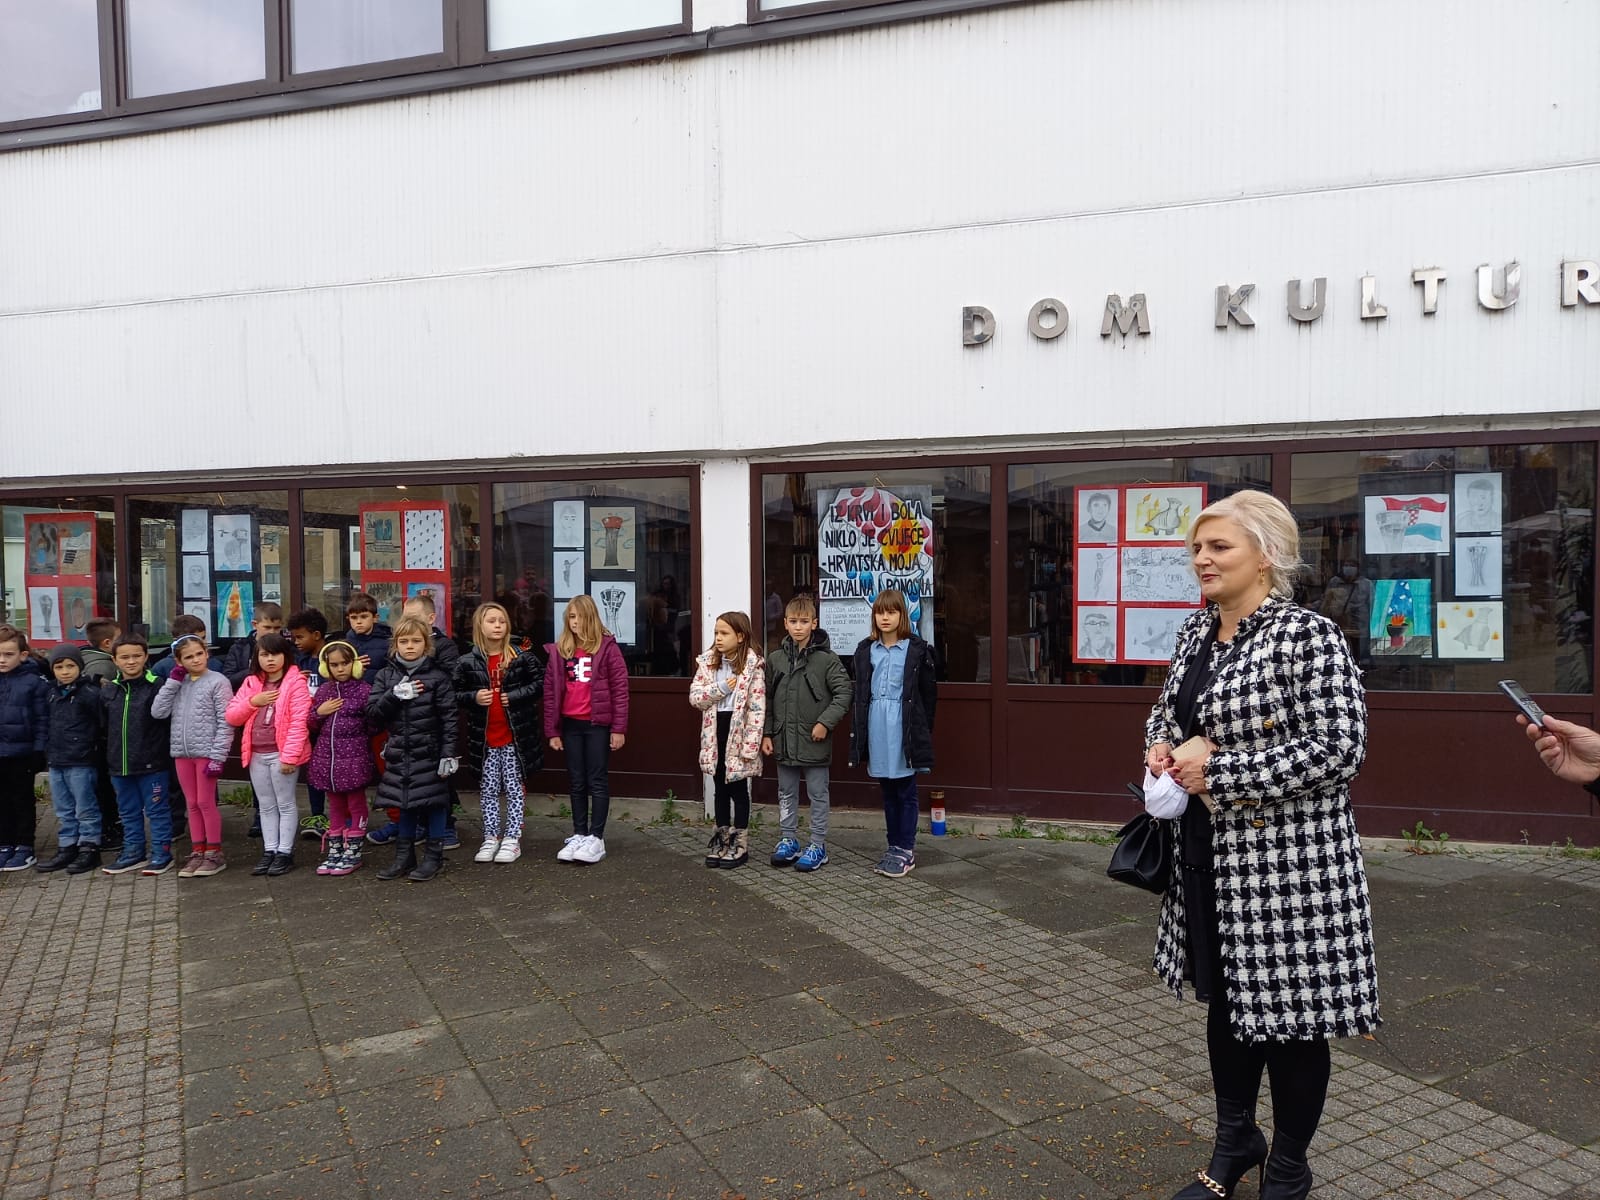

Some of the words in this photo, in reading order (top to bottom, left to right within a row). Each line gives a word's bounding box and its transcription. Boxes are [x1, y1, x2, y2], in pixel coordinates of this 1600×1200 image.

[963, 293, 1151, 346] DOM
[1214, 258, 1600, 328] KULTUR
[830, 506, 842, 523] IZ
[848, 504, 874, 522] KRVI
[891, 502, 923, 520] BOLA
[825, 530, 856, 548] NIKLO
[862, 529, 875, 547] JE
[881, 523, 924, 546] CVIJEĆE
[889, 553, 920, 571] MOJA
[821, 579, 874, 597] ZAHVALNA
[886, 578, 932, 596] PONOSNA
